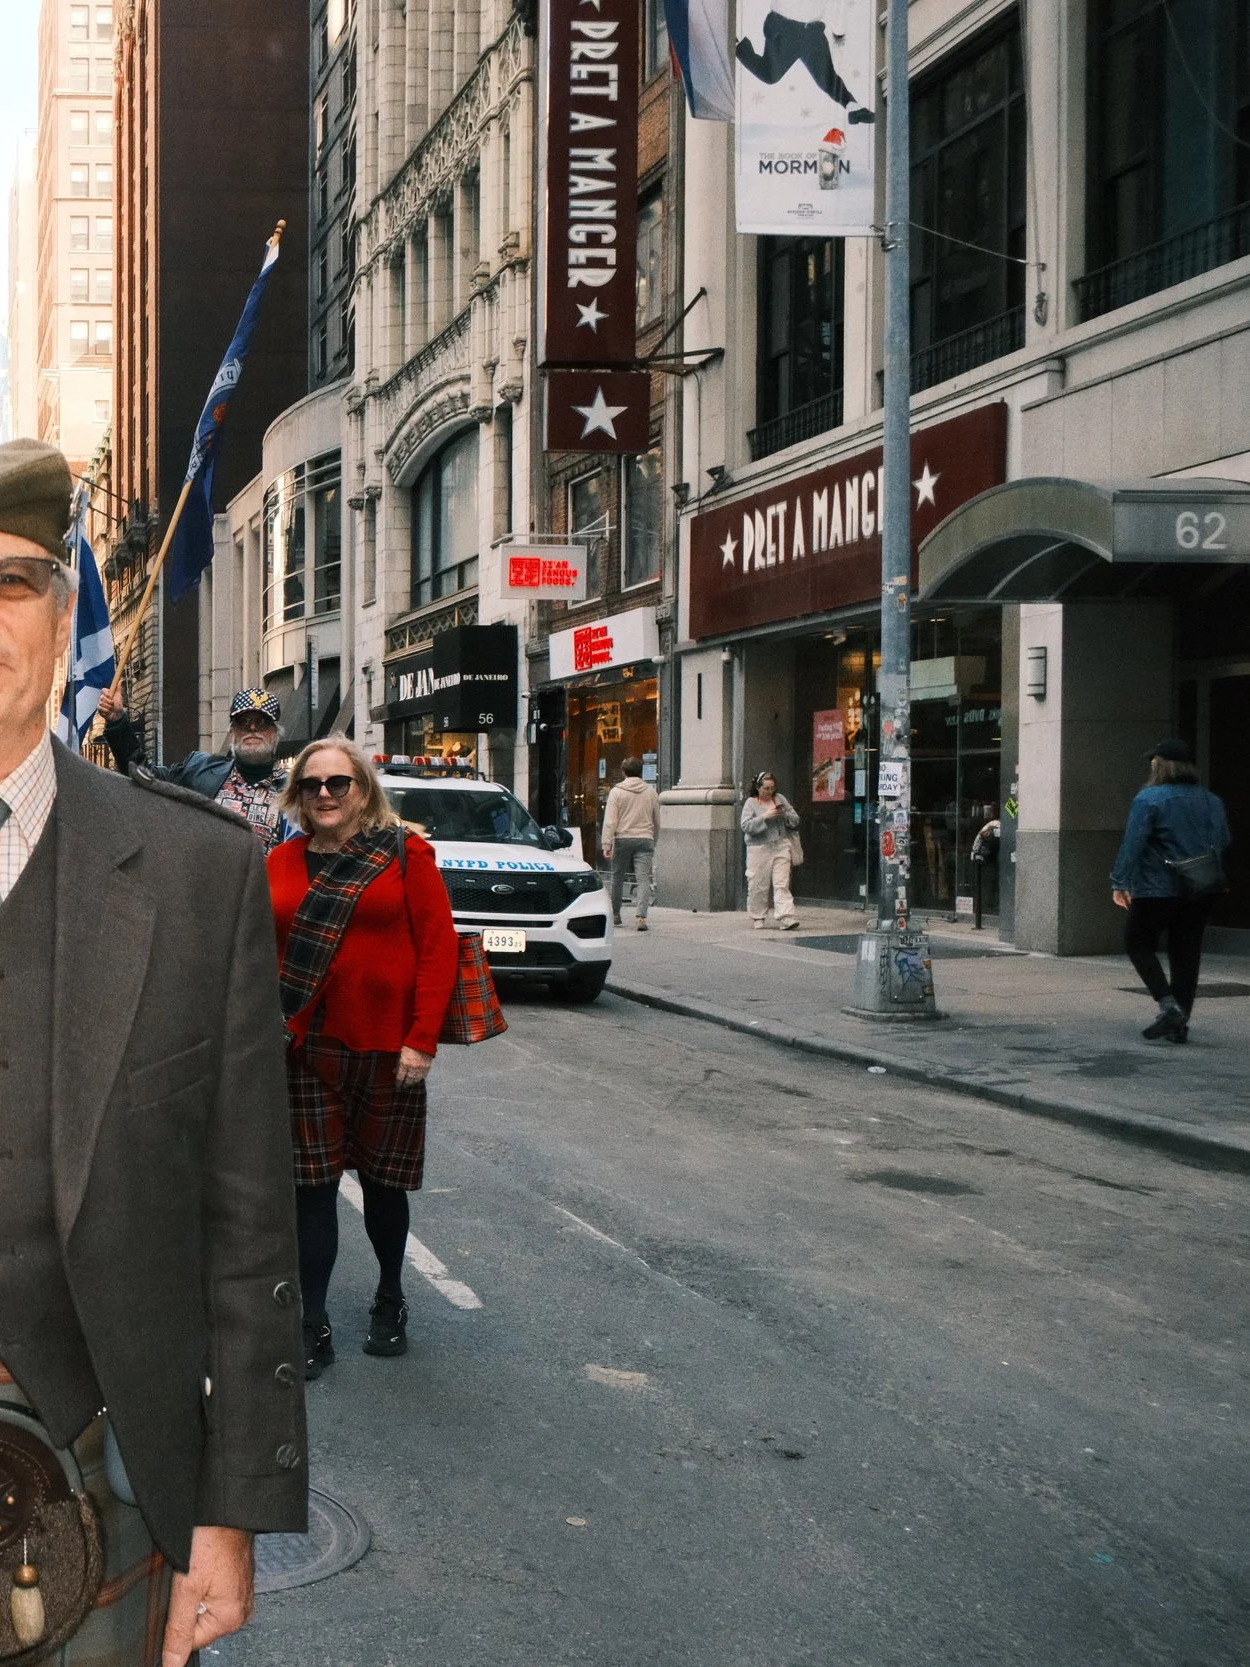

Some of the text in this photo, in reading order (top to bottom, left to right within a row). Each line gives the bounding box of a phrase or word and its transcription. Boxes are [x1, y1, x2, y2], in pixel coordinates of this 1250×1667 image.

[567, 21, 619, 288] PRET A MANGER
[759, 160, 850, 174] MORMN
[743, 466, 883, 573] PRET A MANG
[1176, 512, 1227, 549] 62
[479, 713, 494, 724] 56
[442, 860, 554, 871] NYPD POLICE
[488, 937, 514, 947] 4393
